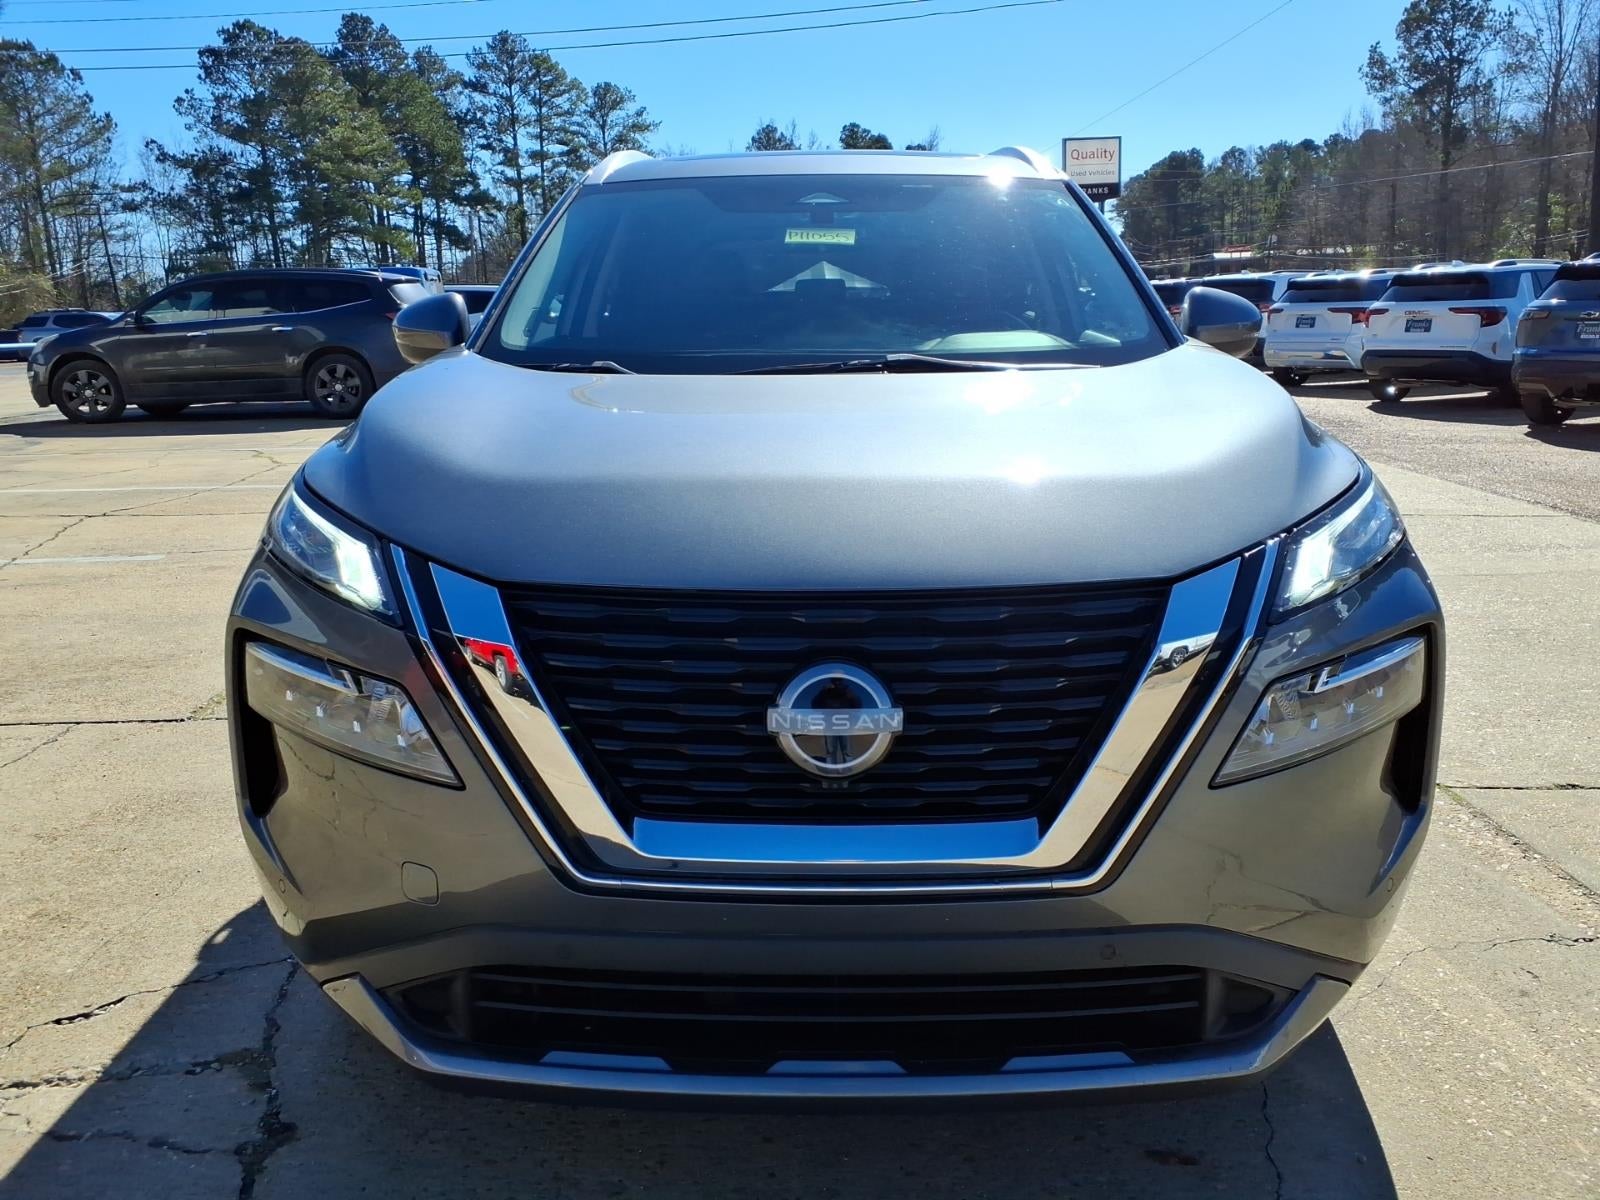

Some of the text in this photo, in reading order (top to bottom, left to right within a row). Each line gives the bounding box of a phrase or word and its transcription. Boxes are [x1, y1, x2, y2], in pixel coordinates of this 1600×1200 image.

[1070, 147, 1115, 162] Quality
[1070, 168, 1115, 177] Used Vehicles
[771, 713, 900, 730] NISSAN
